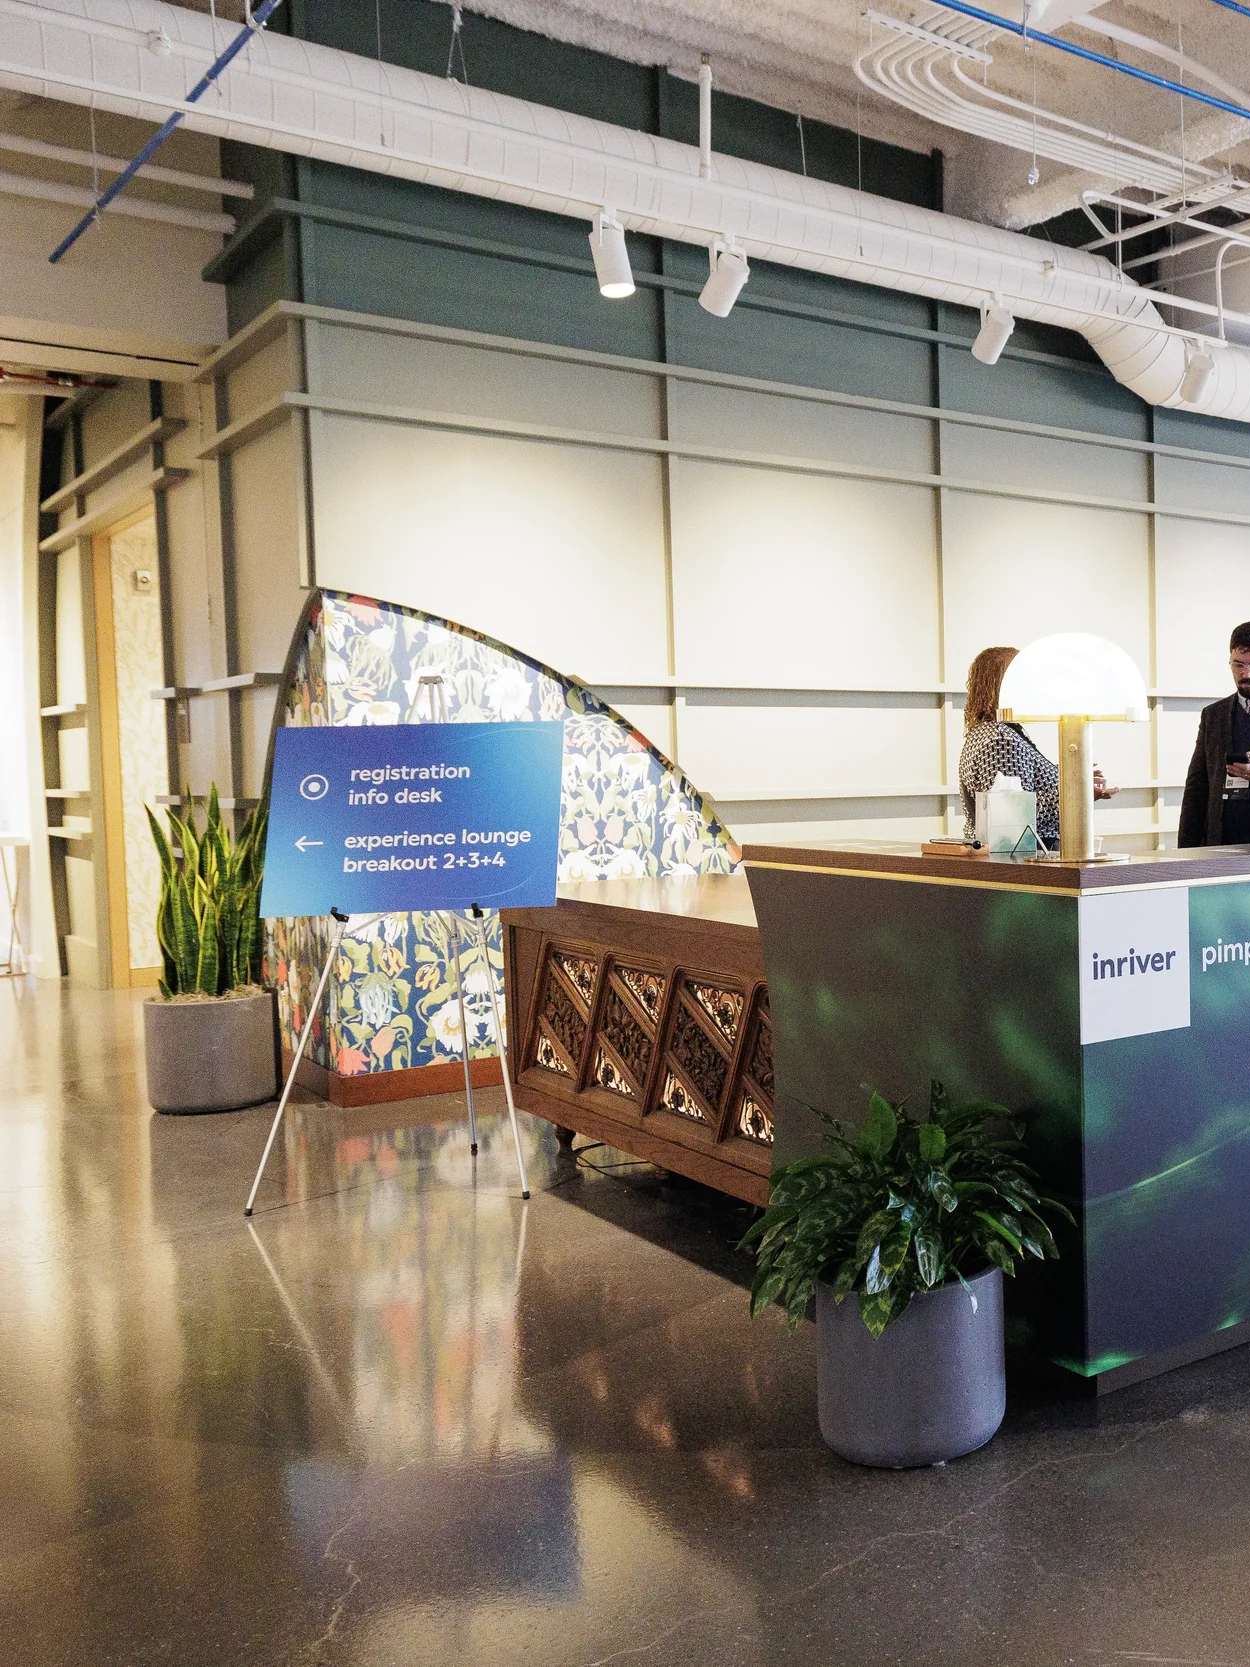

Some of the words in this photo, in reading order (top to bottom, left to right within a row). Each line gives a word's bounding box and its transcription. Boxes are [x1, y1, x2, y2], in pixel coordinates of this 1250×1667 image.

[350, 763, 471, 785] registration
[348, 789, 389, 806] info
[394, 787, 443, 804] desk
[344, 830, 456, 852] experience
[461, 829, 532, 847] lounge
[343, 855, 438, 873] breakout
[443, 851, 506, 869] 2+3+4
[1092, 948, 1176, 980] inriver
